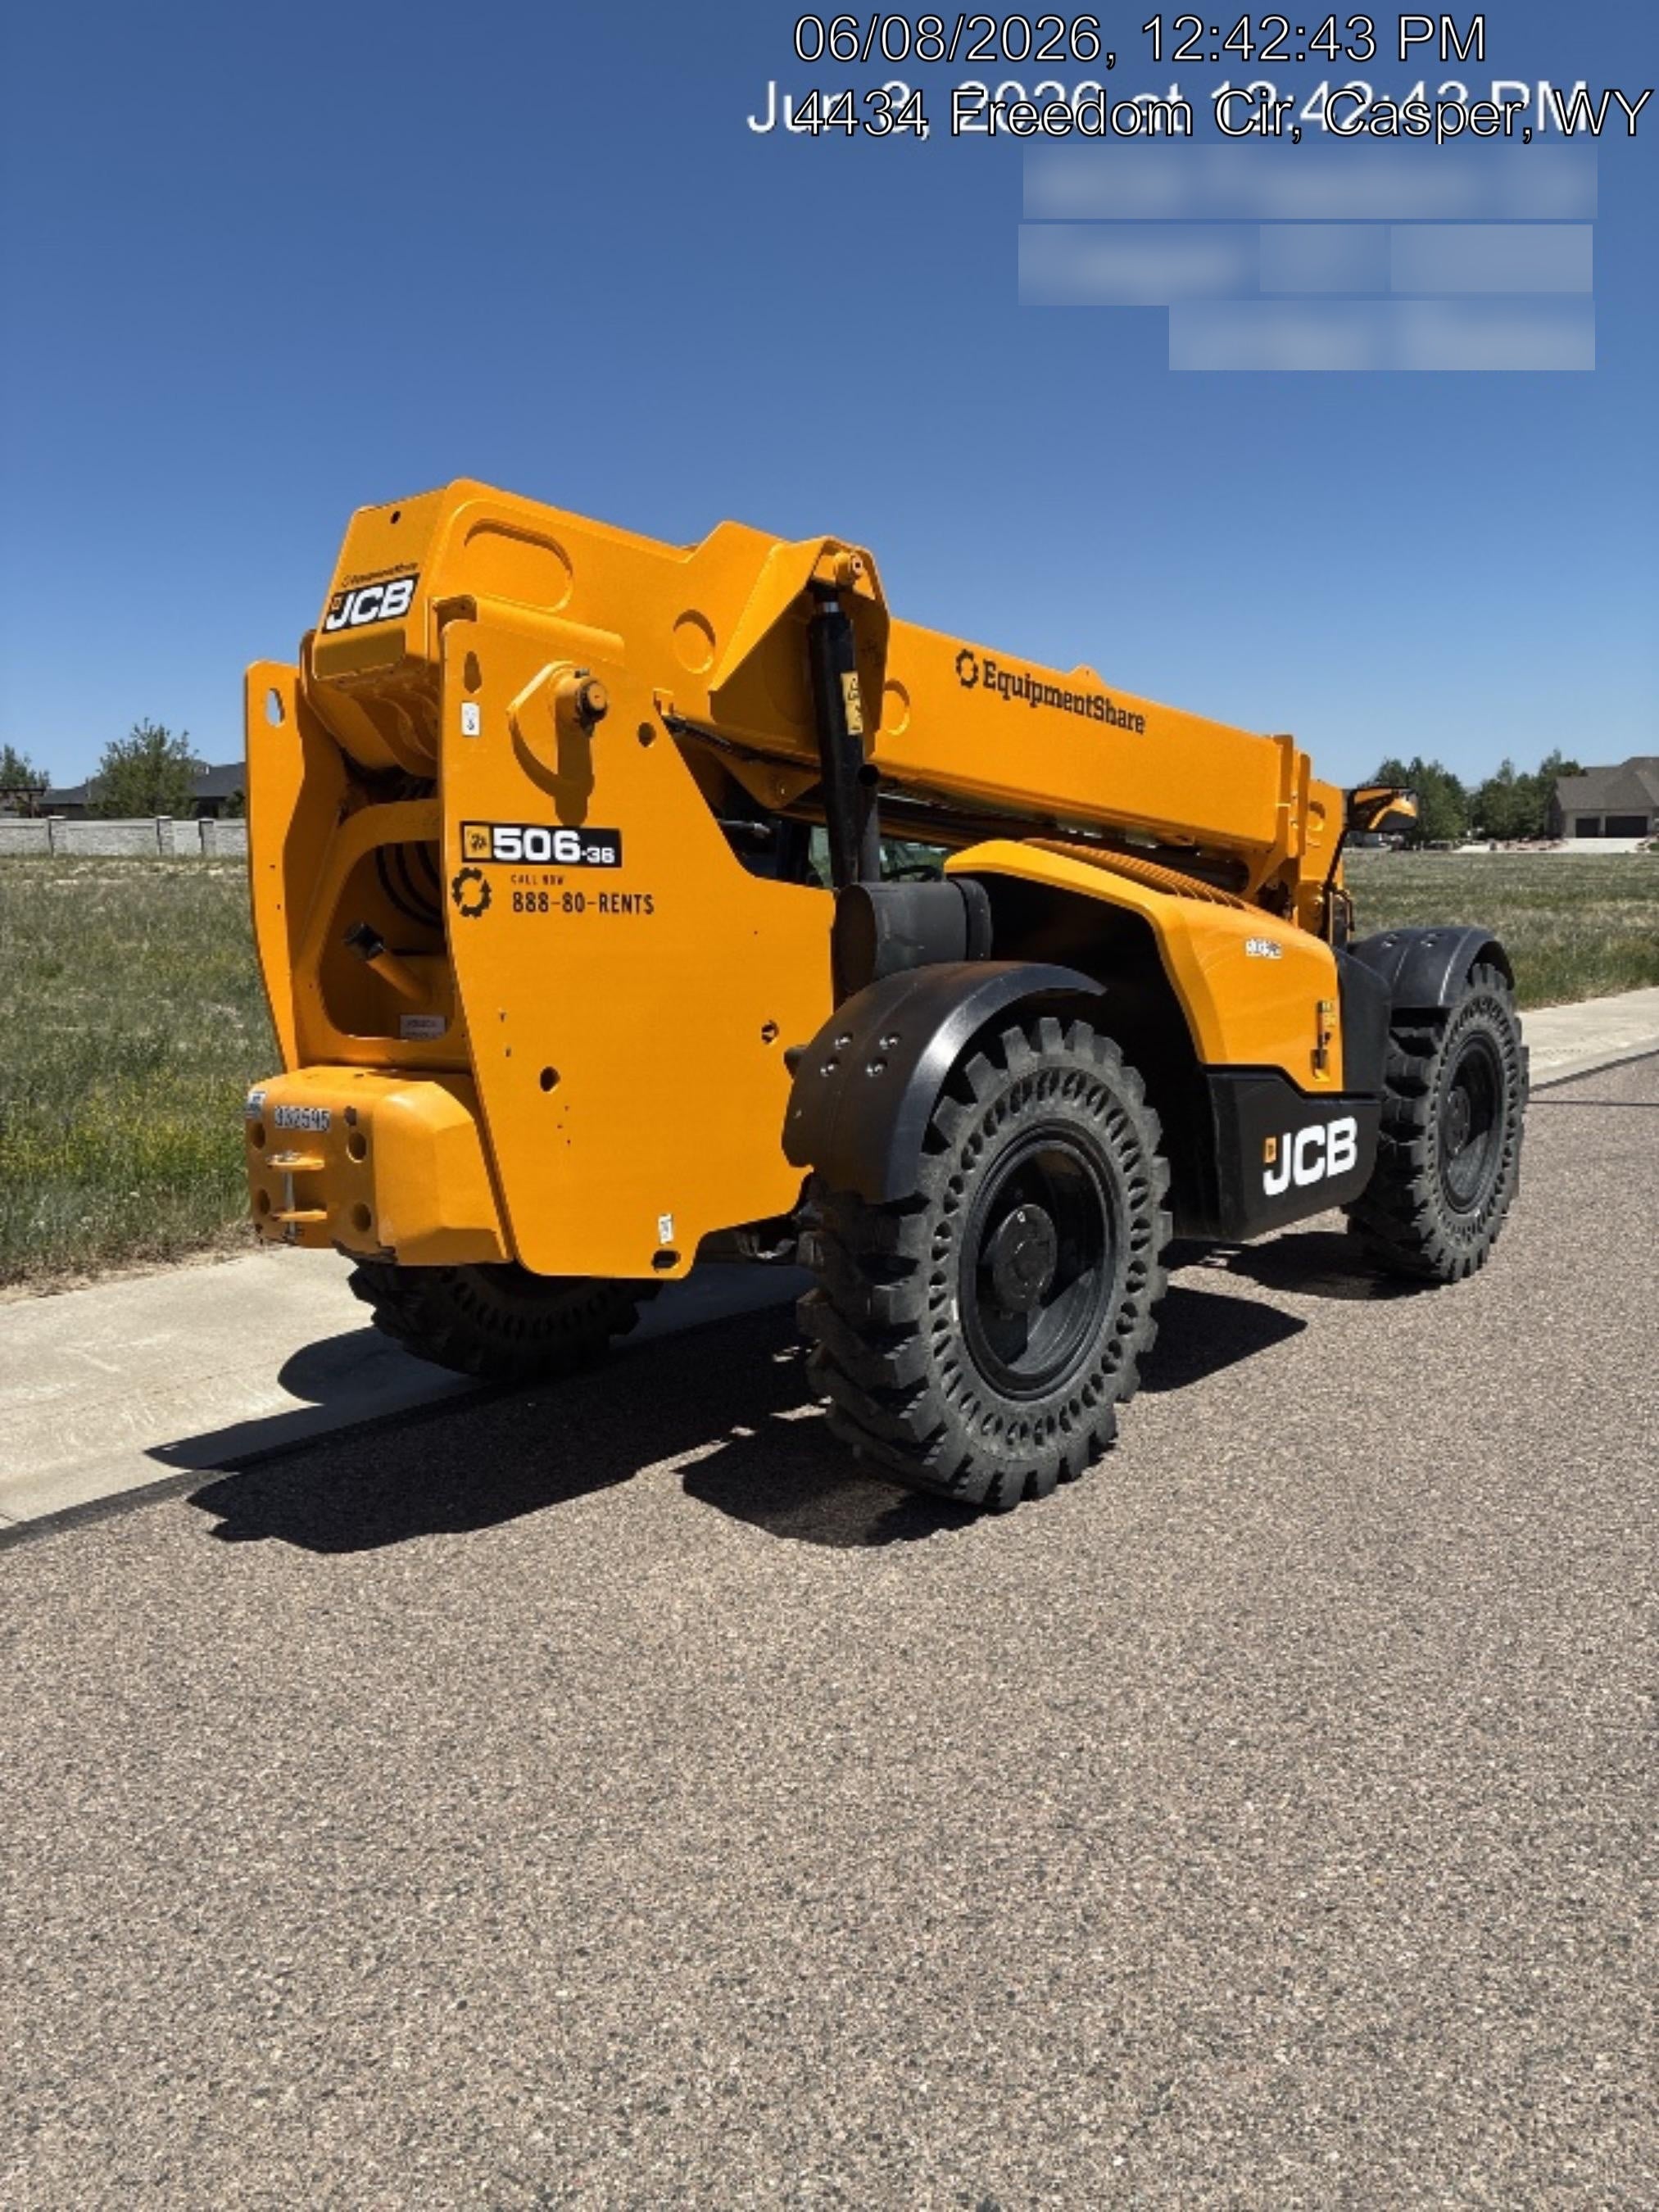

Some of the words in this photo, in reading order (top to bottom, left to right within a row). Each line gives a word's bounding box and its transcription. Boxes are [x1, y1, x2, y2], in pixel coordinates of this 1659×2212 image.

[325, 578, 415, 631] JCB
[982, 658, 1148, 735] EquipmentShare
[510, 874, 538, 886] CALL
[542, 874, 565, 886] NOW
[512, 891, 655, 915] 888-80-RENTS
[1262, 1116, 1358, 1196] JCB
